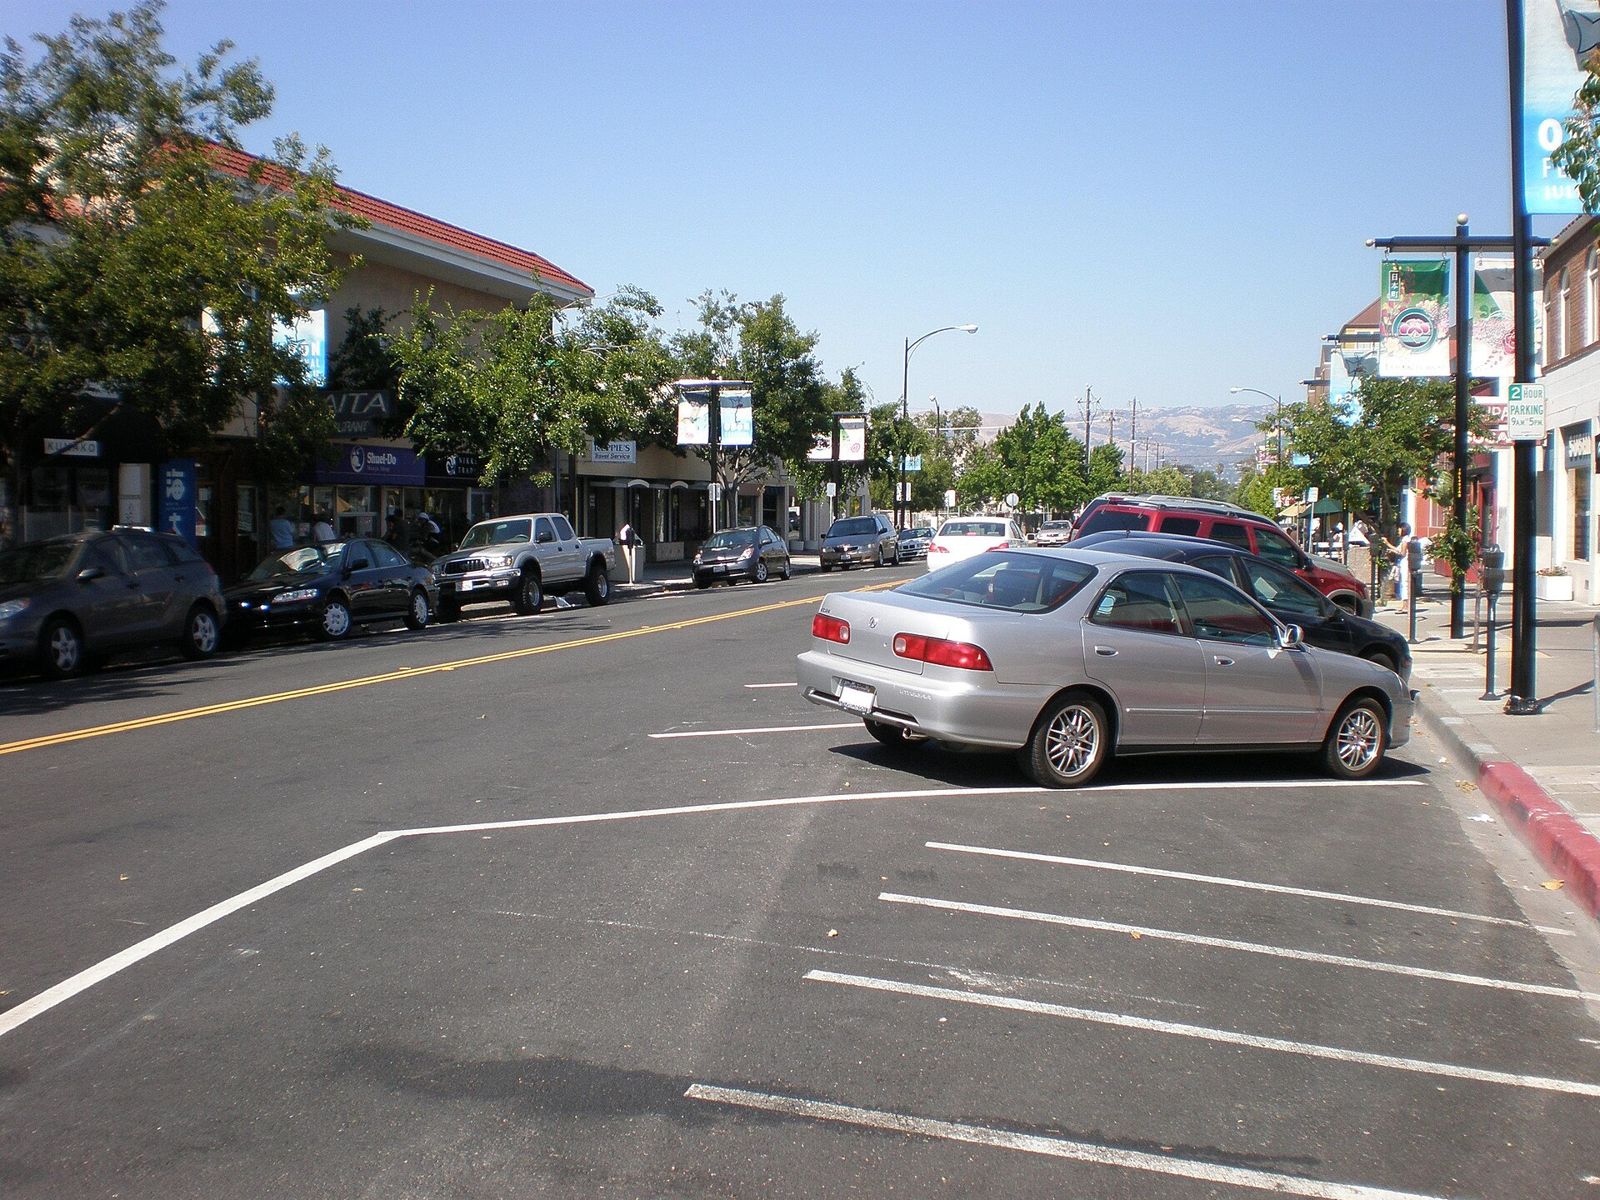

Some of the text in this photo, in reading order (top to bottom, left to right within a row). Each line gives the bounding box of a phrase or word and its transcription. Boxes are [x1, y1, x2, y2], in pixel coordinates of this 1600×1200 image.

[1511, 387, 1543, 399] 2 HOUR
[1510, 404, 1543, 415] PARKING
